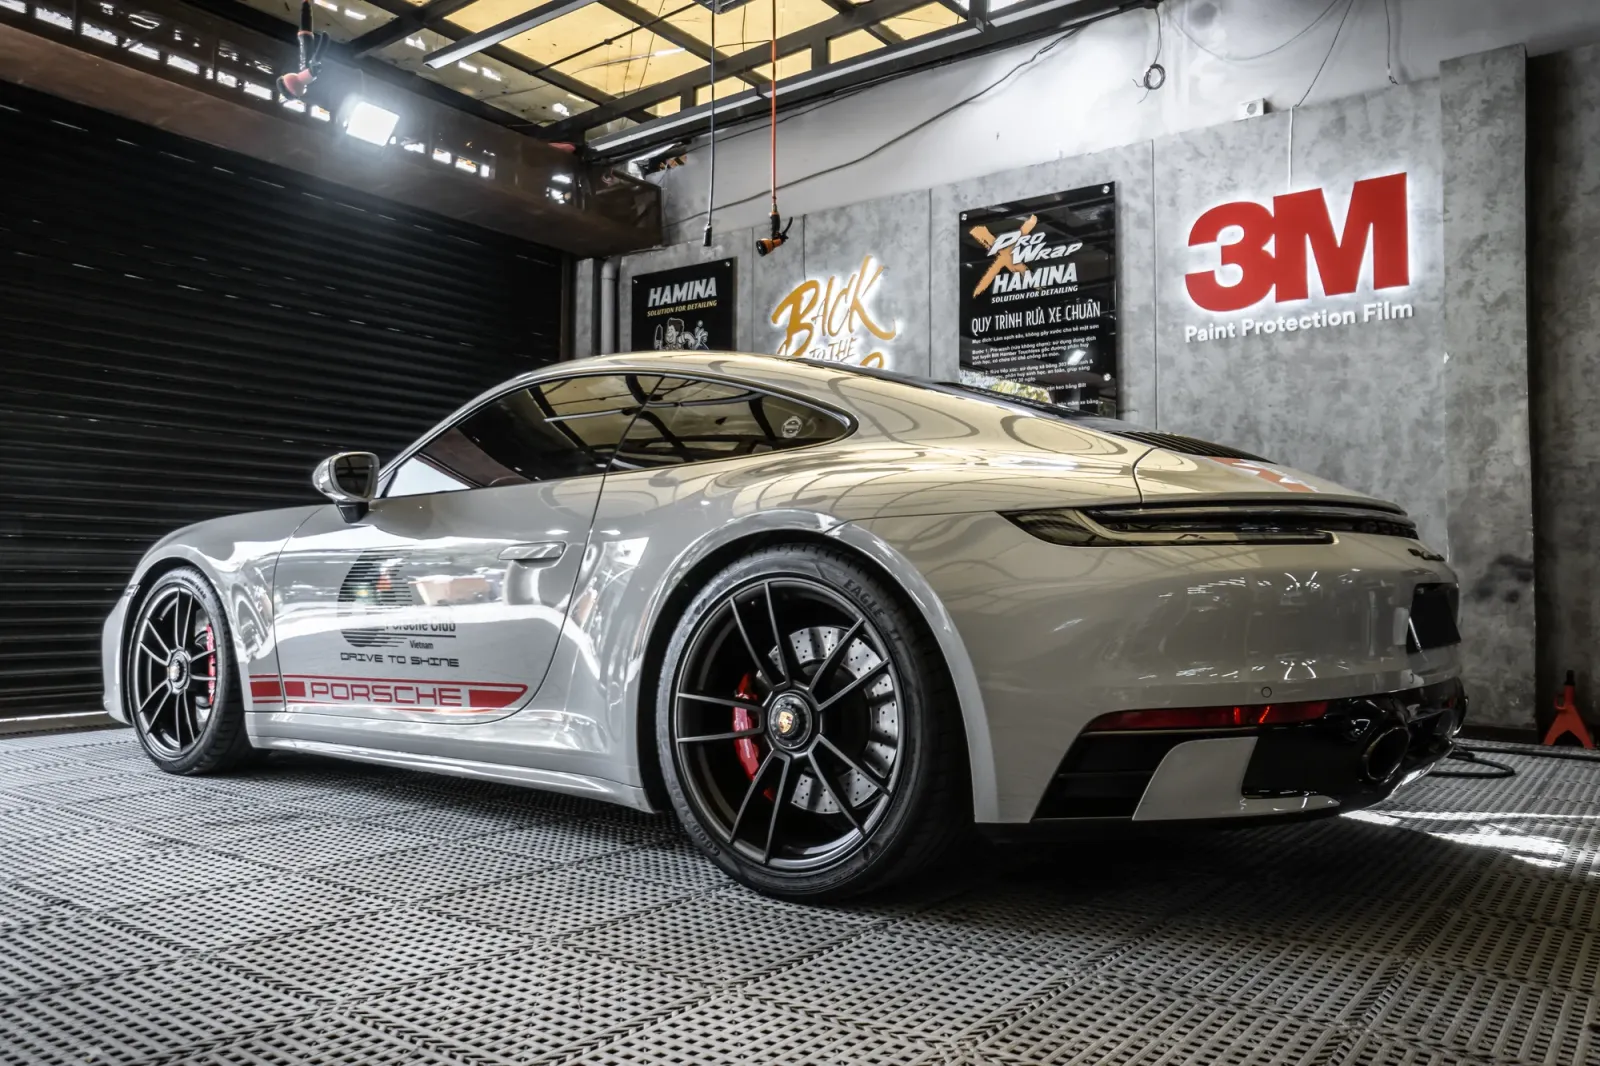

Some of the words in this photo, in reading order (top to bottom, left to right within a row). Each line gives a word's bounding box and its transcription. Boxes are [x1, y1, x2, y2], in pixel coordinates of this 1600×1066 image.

[1185, 172, 1410, 312] 3M
[648, 277, 717, 308] HAMINA
[992, 262, 1077, 294] HAMINA
[647, 307, 674, 317] SOLUTION
[687, 300, 717, 311] DETAILING
[771, 255, 897, 356] BACK
[991, 293, 1024, 304] SOLUTION
[1025, 291, 1040, 299] FOR
[1041, 285, 1078, 296] DETAILING
[971, 315, 992, 336] QUY
[995, 311, 1023, 330] TRÌNH
[1048, 306, 1062, 323] XE
[1185, 323, 1236, 343] Paint
[1242, 309, 1356, 337] Protection
[1363, 301, 1414, 323] Film
[828, 338, 857, 361] THE
[843, 579, 884, 617] EAGLE
[340, 652, 384, 662] DRIVE
[388, 655, 406, 664] TO
[410, 656, 460, 667] SHINE
[409, 640, 434, 649] Vietnam
[311, 682, 462, 706] PORSCHE
